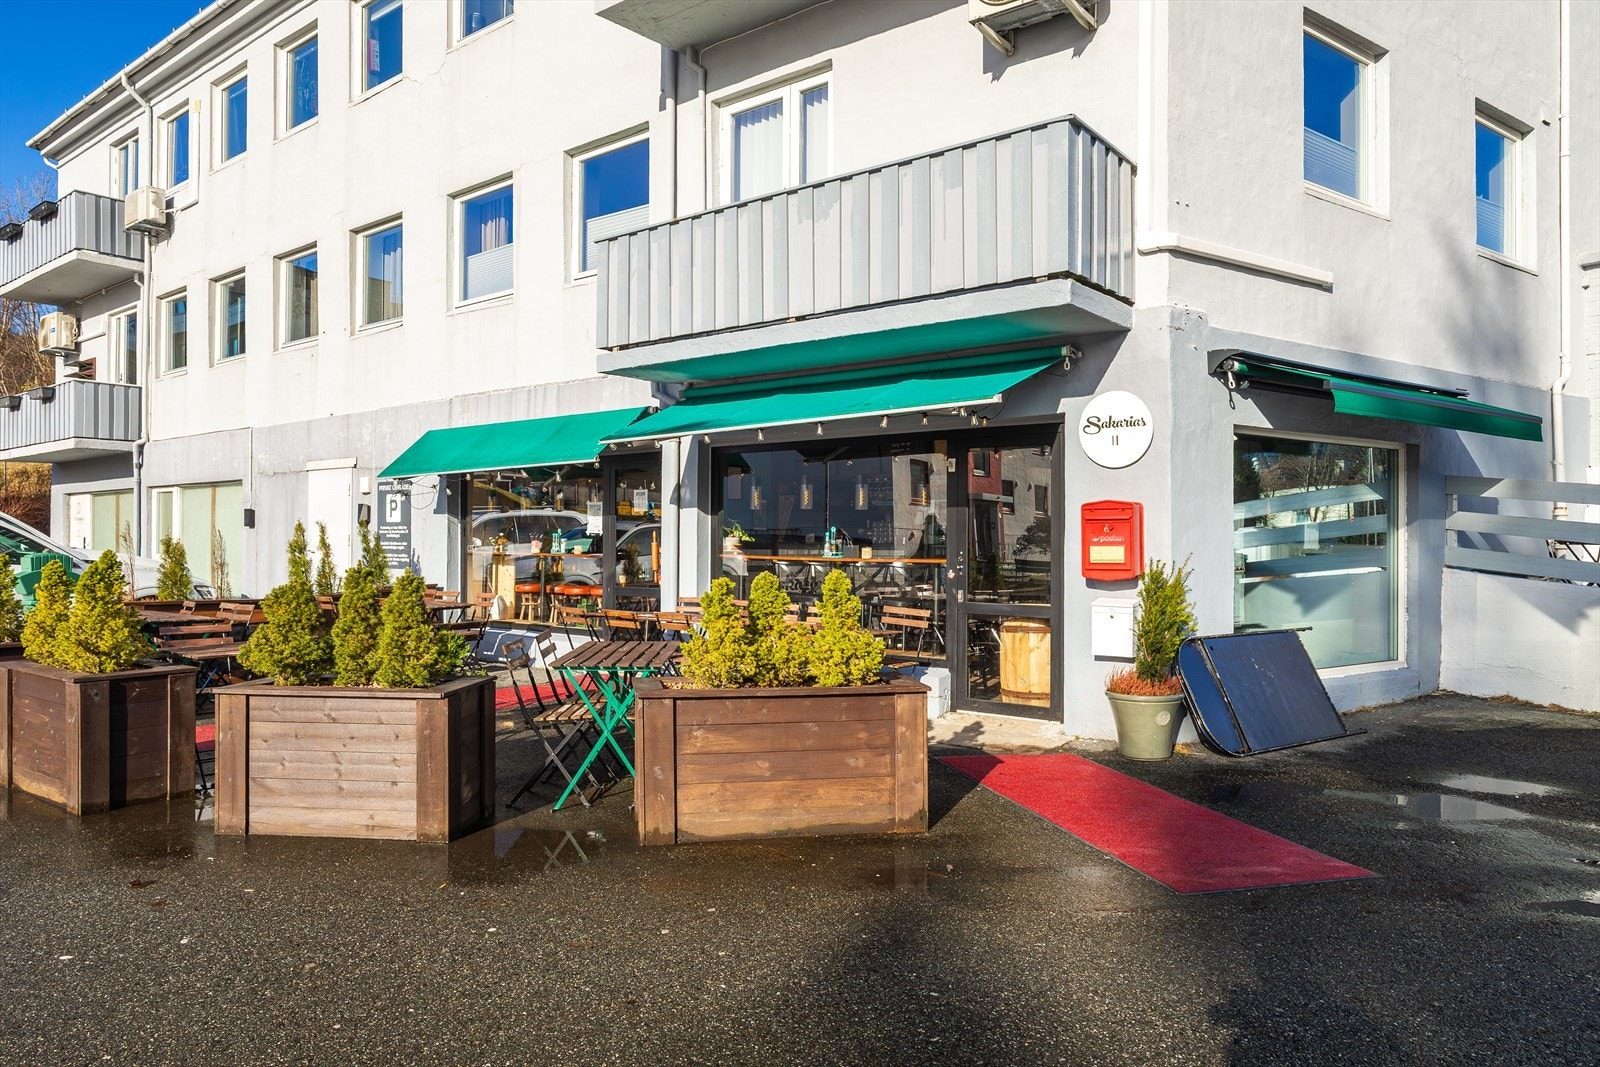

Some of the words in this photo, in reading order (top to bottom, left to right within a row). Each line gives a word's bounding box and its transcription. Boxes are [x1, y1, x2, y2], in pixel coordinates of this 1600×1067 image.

[1083, 415, 1147, 435] Sakarias
[390, 499, 397, 517] P
[1100, 534, 1125, 543] posten
